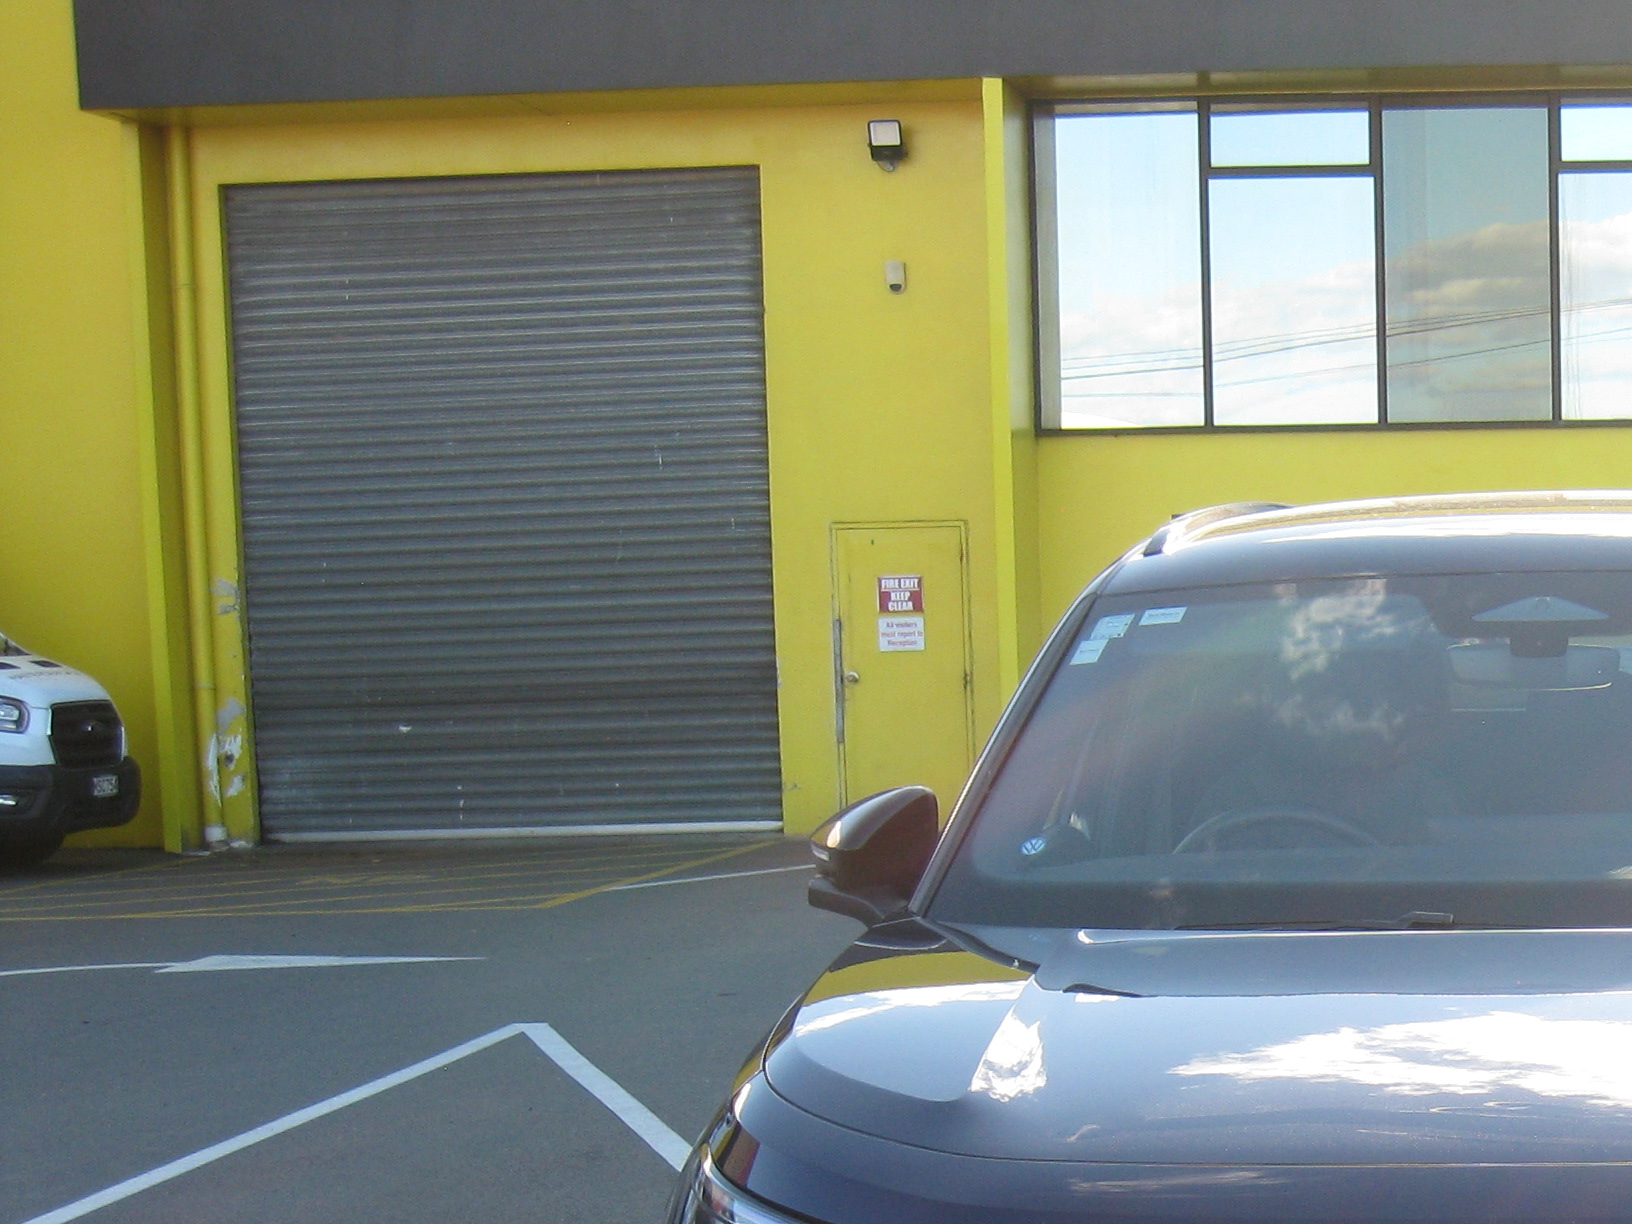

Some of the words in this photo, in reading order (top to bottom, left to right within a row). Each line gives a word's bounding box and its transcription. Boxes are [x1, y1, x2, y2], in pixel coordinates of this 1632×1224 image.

[881, 579, 899, 588] FIRE
[901, 579, 918, 588] EXIT
[891, 591, 911, 600] KEEP
[888, 601, 913, 611] CLEAR
